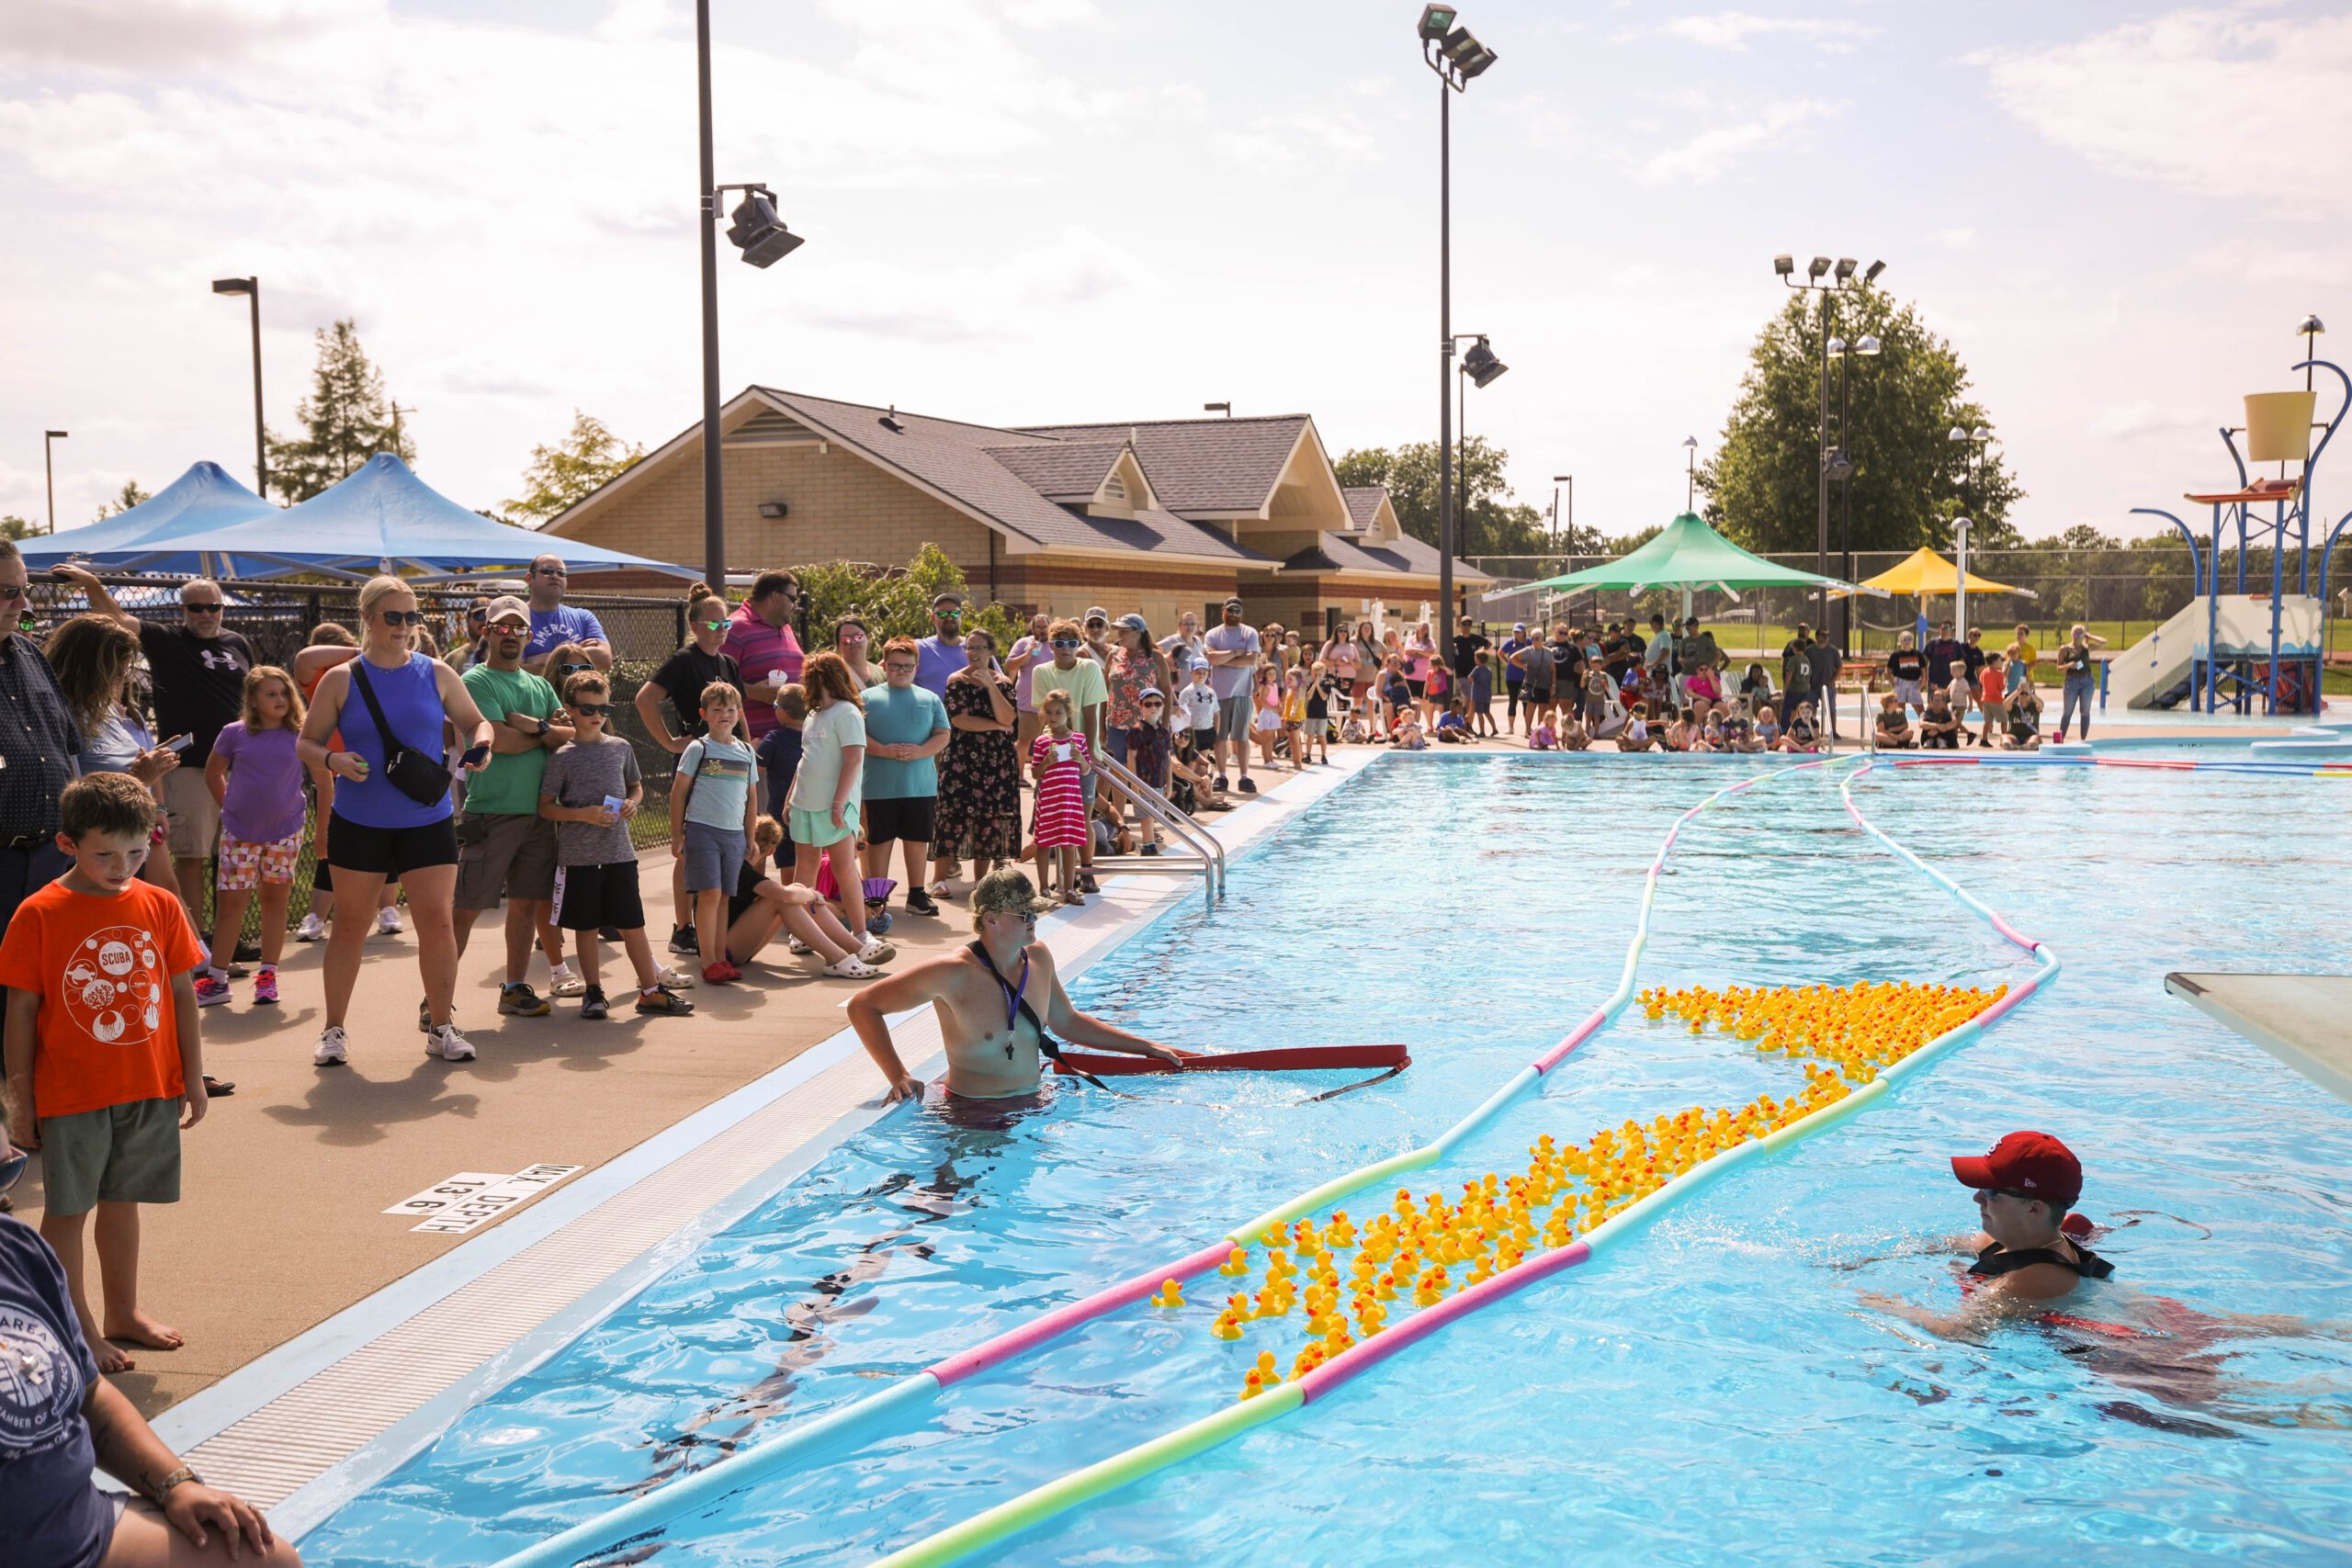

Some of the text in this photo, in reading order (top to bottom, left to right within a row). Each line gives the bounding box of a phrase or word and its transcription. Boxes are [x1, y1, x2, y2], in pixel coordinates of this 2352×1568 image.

[102, 952, 130, 965] SCUBA
[434, 1181, 485, 1195] 13
[405, 1201, 446, 1209] 6
[419, 1164, 574, 1232] MAX. DEPTH
[0, 1315, 47, 1342] AREA
[0, 1406, 31, 1428] AMBER
[35, 1412, 48, 1425] OF
